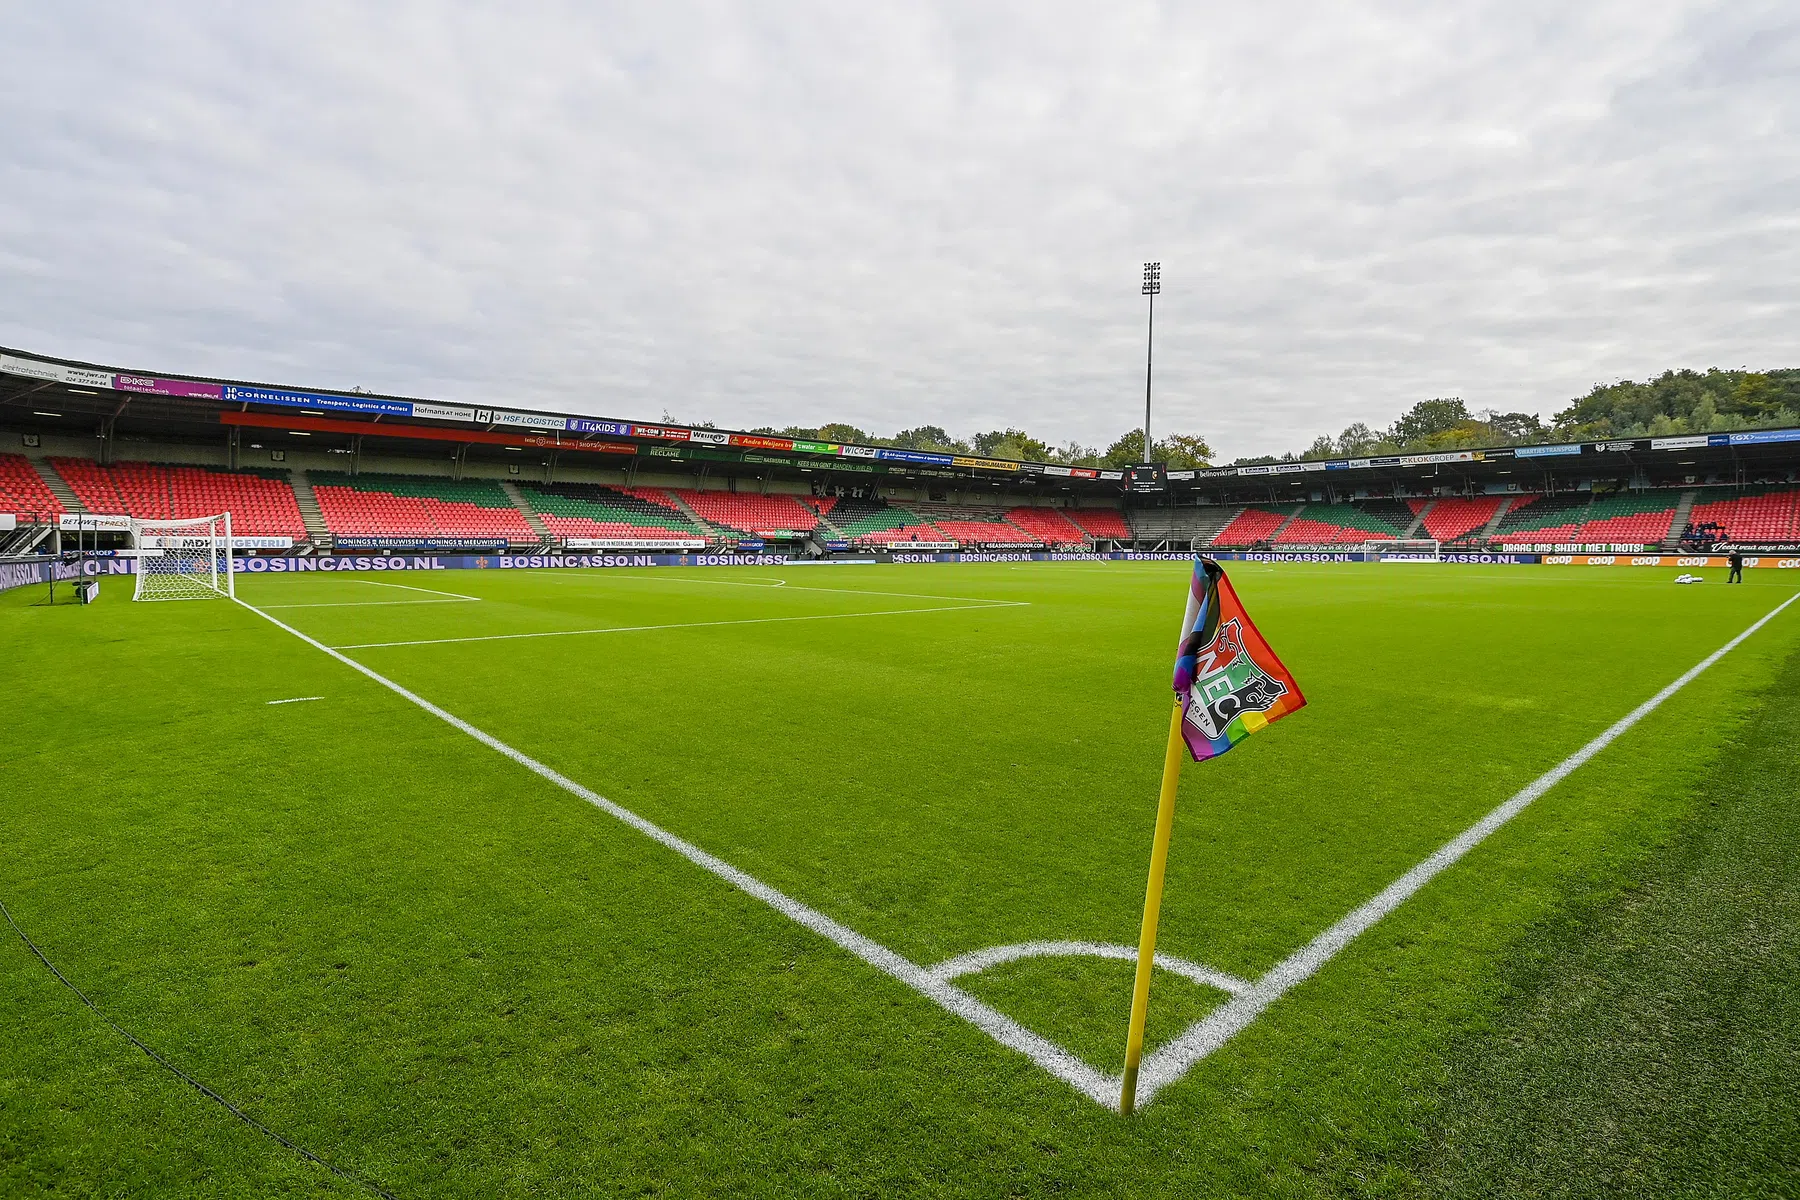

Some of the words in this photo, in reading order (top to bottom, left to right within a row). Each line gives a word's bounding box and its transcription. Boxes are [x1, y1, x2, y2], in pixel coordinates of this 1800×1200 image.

[2, 363, 58, 379] elektrotechniek
[67, 369, 108, 379] www.jwr.nl
[237, 391, 310, 403] CORNELISSEN
[316, 398, 350, 408] Transport,
[352, 402, 379, 410] Logistics
[415, 406, 446, 416] Hofmans
[503, 414, 521, 423] HSF
[522, 416, 565, 427] LOGISTICS
[581, 421, 616, 433] IT4KIDS
[650, 450, 680, 458] RECLAME
[844, 446, 865, 455] WICO
[1407, 454, 1455, 463] KLOKGROEP
[1503, 544, 1531, 552] DRAAG
[1534, 544, 1552, 552] ONS
[1555, 544, 1583, 552] SHIRT
[1585, 544, 1608, 552] MET
[1610, 544, 1644, 552] TROTS!
[500, 555, 656, 568] BOSINCASSO.NL
[960, 554, 1033, 562] BOSINCASSO.NL
[1246, 554, 1352, 562] BOSINCASSO.NL
[1546, 556, 1573, 565] coop
[1588, 556, 1615, 565] coop
[1631, 556, 1660, 566] coop
[1677, 557, 1708, 567] coop
[1726, 557, 1759, 568] cop
[232, 557, 445, 572] BOSINCASSO.NL
